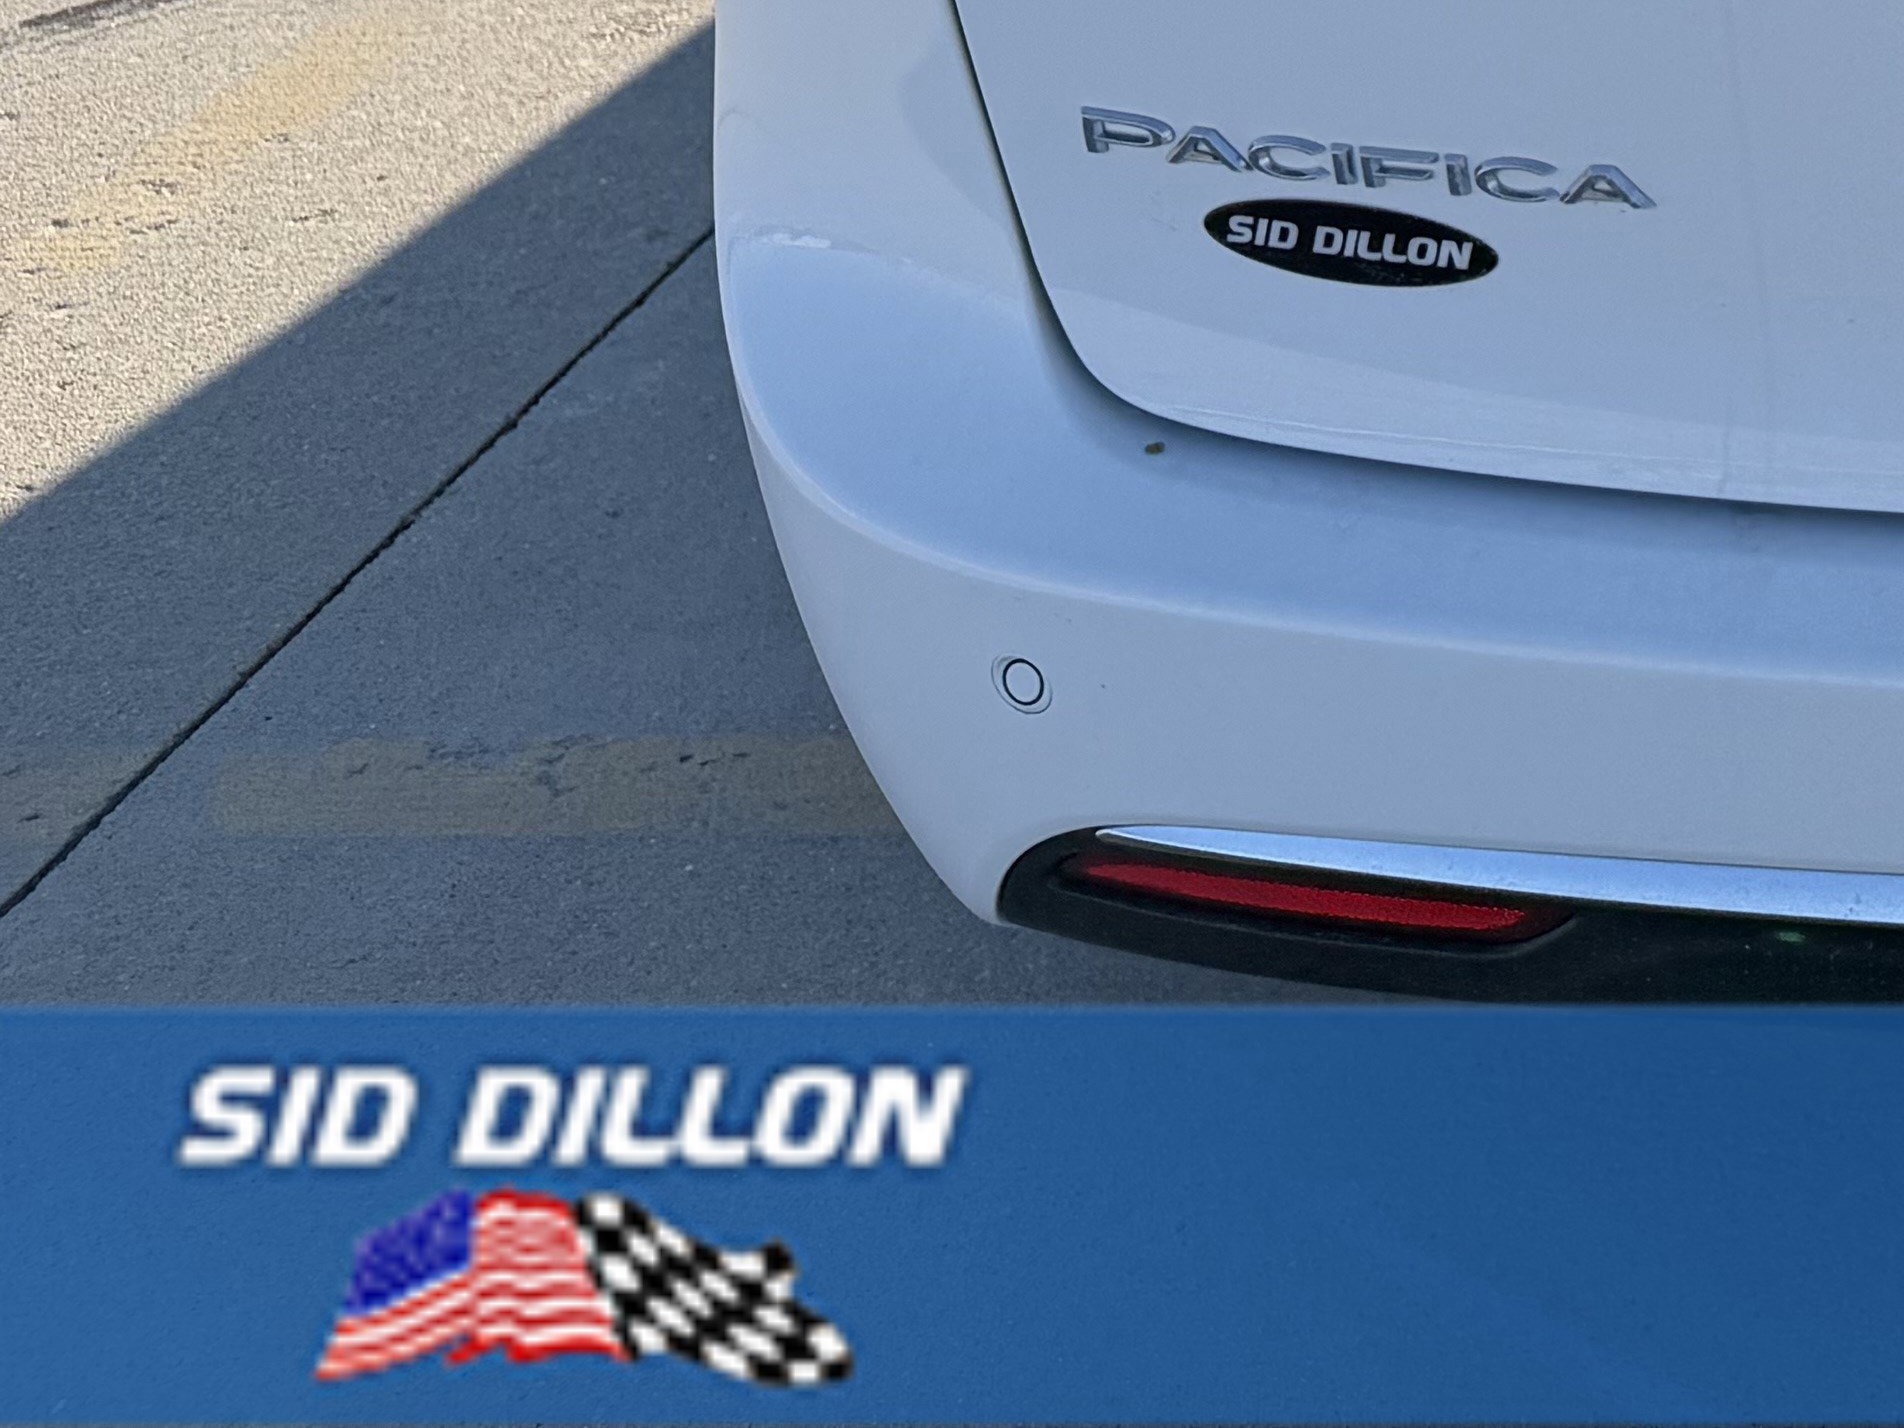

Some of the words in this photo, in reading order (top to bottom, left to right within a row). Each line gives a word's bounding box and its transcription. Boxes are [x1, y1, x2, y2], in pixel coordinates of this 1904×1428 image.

[1081, 105, 1657, 209] PACIFICA
[1226, 215, 1300, 251] SID
[1312, 224, 1474, 271] DILLON
